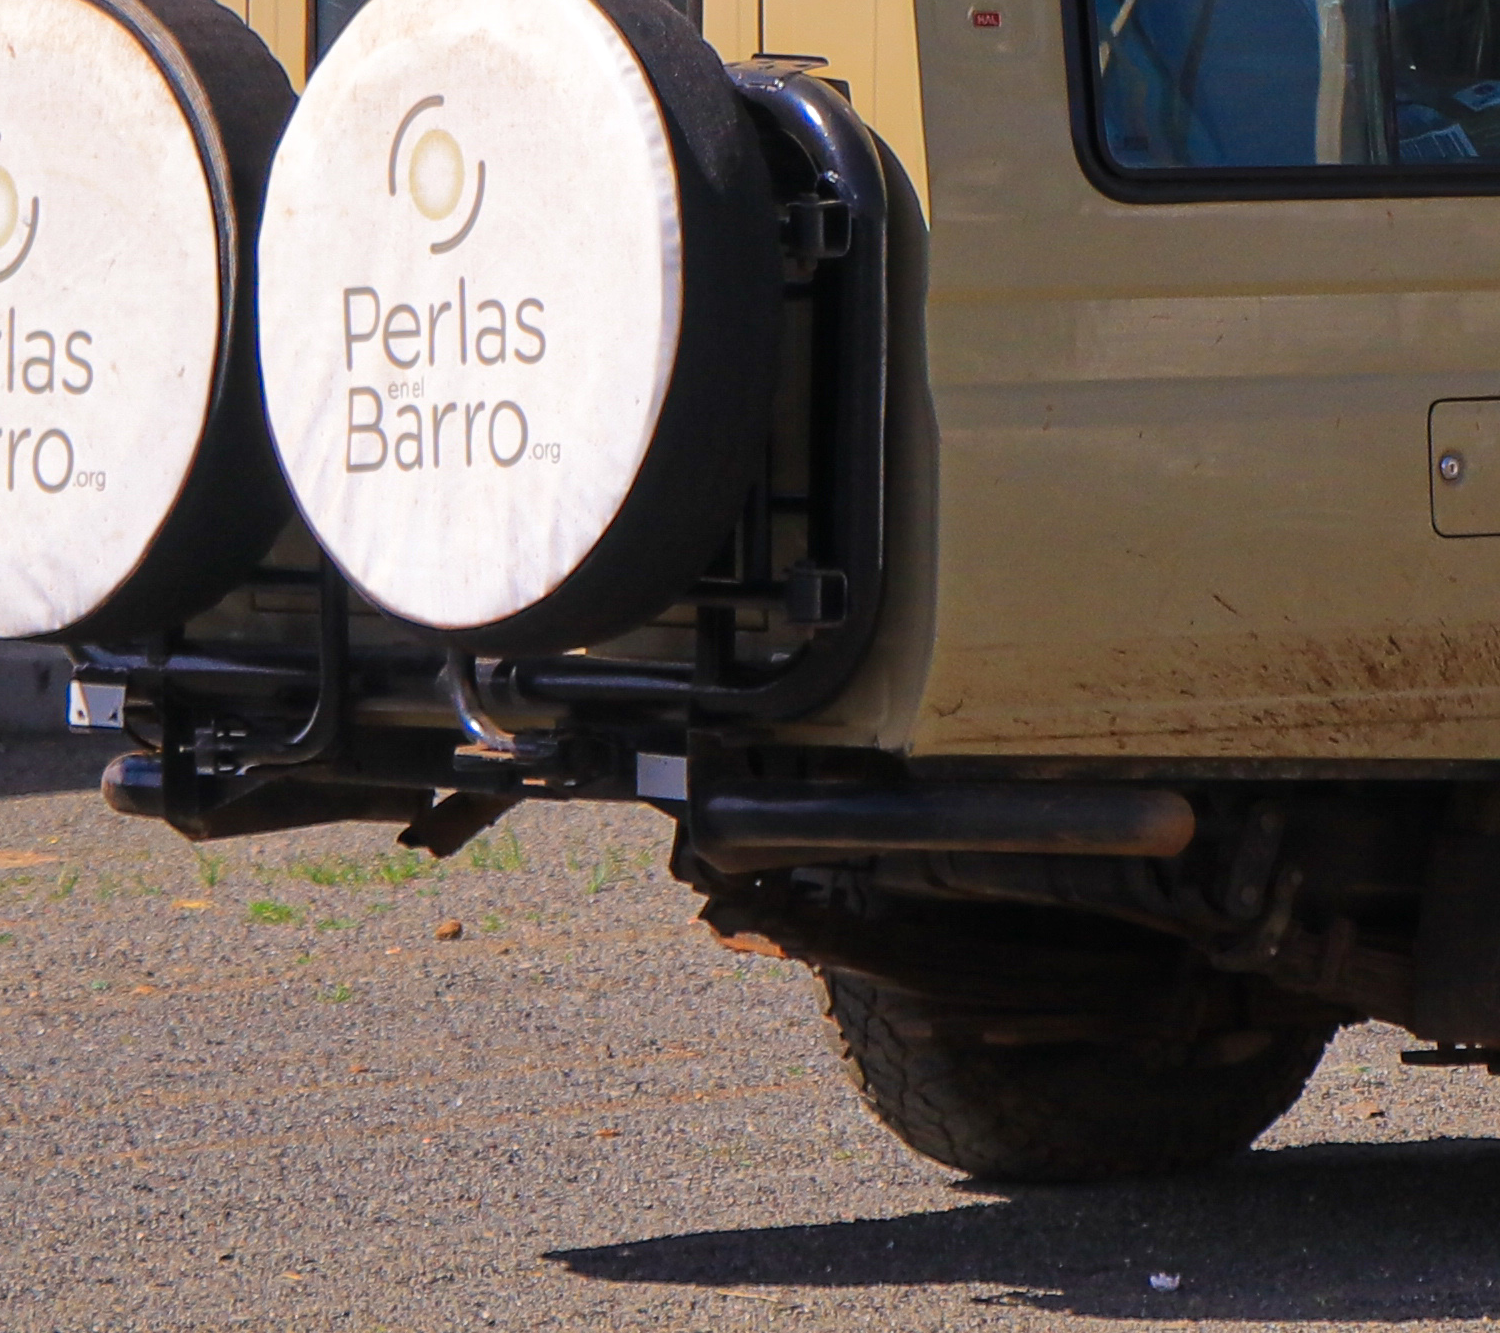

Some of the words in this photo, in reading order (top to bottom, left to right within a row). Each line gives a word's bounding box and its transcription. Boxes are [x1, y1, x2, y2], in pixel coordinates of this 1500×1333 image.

[343, 276, 547, 371] Perlas
[388, 381, 410, 400] en
[412, 377, 425, 399] el
